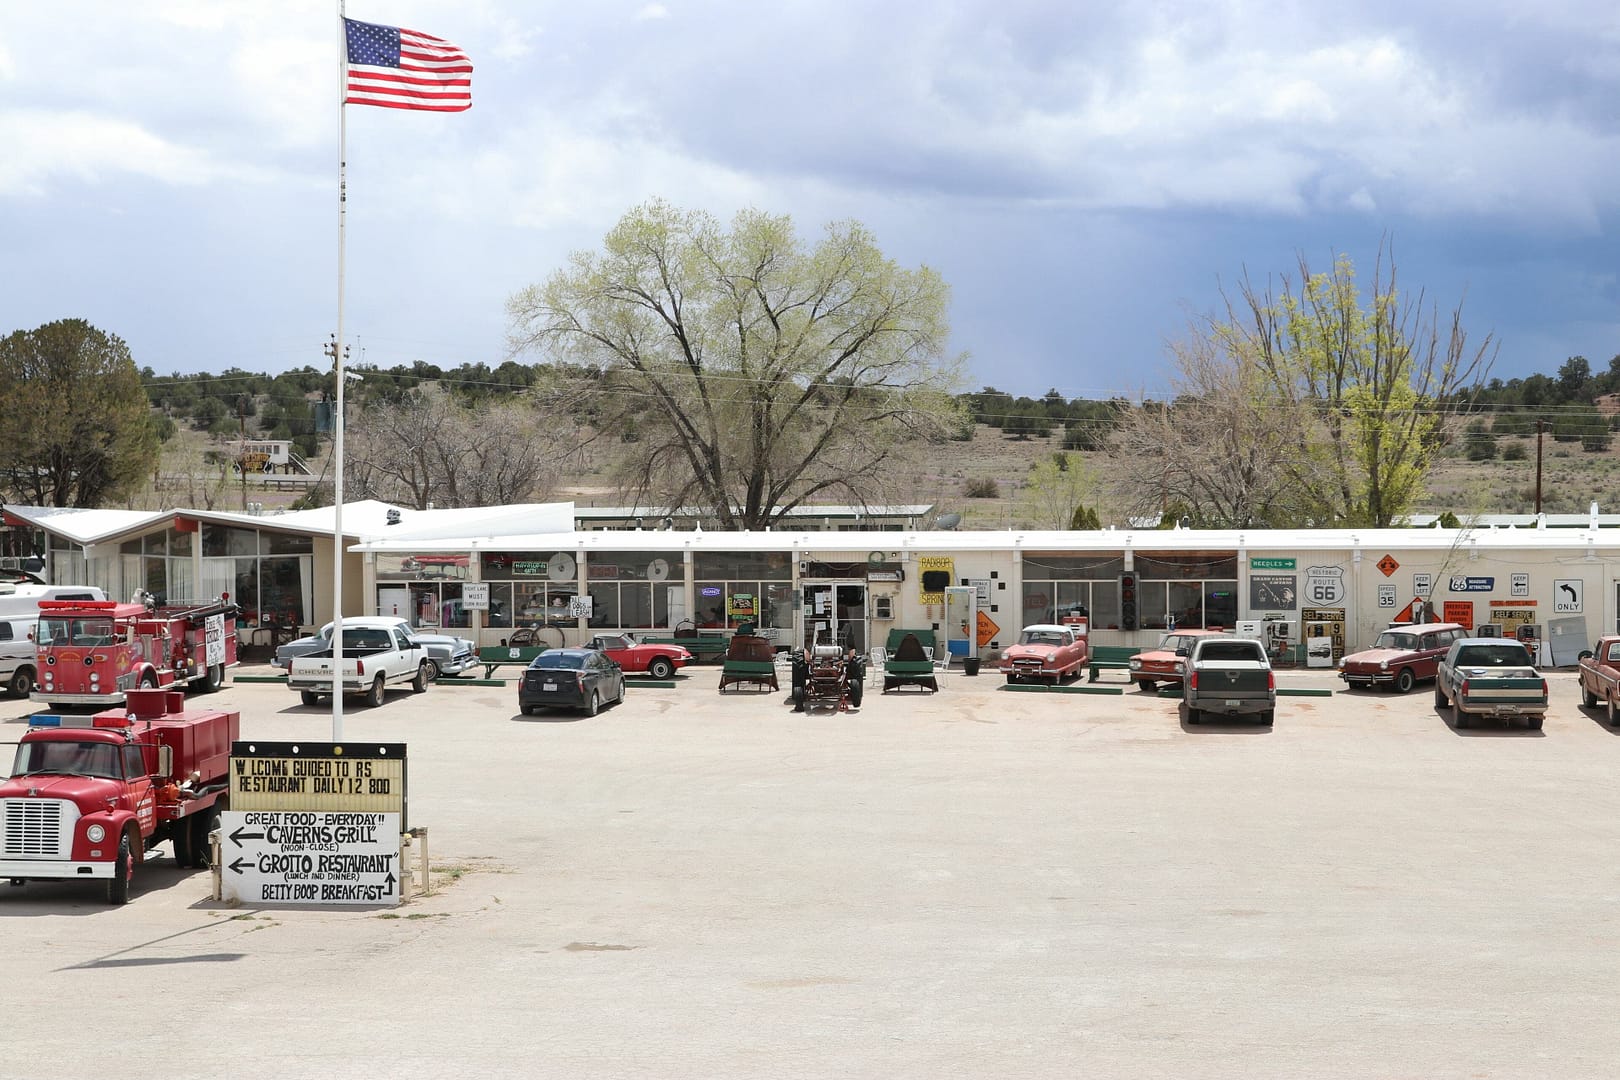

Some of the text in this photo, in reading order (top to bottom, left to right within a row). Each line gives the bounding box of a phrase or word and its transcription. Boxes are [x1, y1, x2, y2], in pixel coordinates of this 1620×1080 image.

[1453, 580, 1466, 590] 66
[1314, 586, 1336, 600] 66
[1380, 596, 1394, 606] 35
[1302, 610, 1344, 620] SELF SERVE
[1333, 623, 1340, 634] 9
[293, 760, 332, 777] GUIDED
[240, 776, 307, 792] RESTAURANT
[314, 778, 344, 793] DAILY
[349, 778, 362, 794] 12
[245, 813, 282, 825] GREAT
[284, 813, 316, 825] FOOD
[284, 873, 309, 882] (LUNCH
[262, 884, 384, 900] BETTY BOOP BREAKFAST
